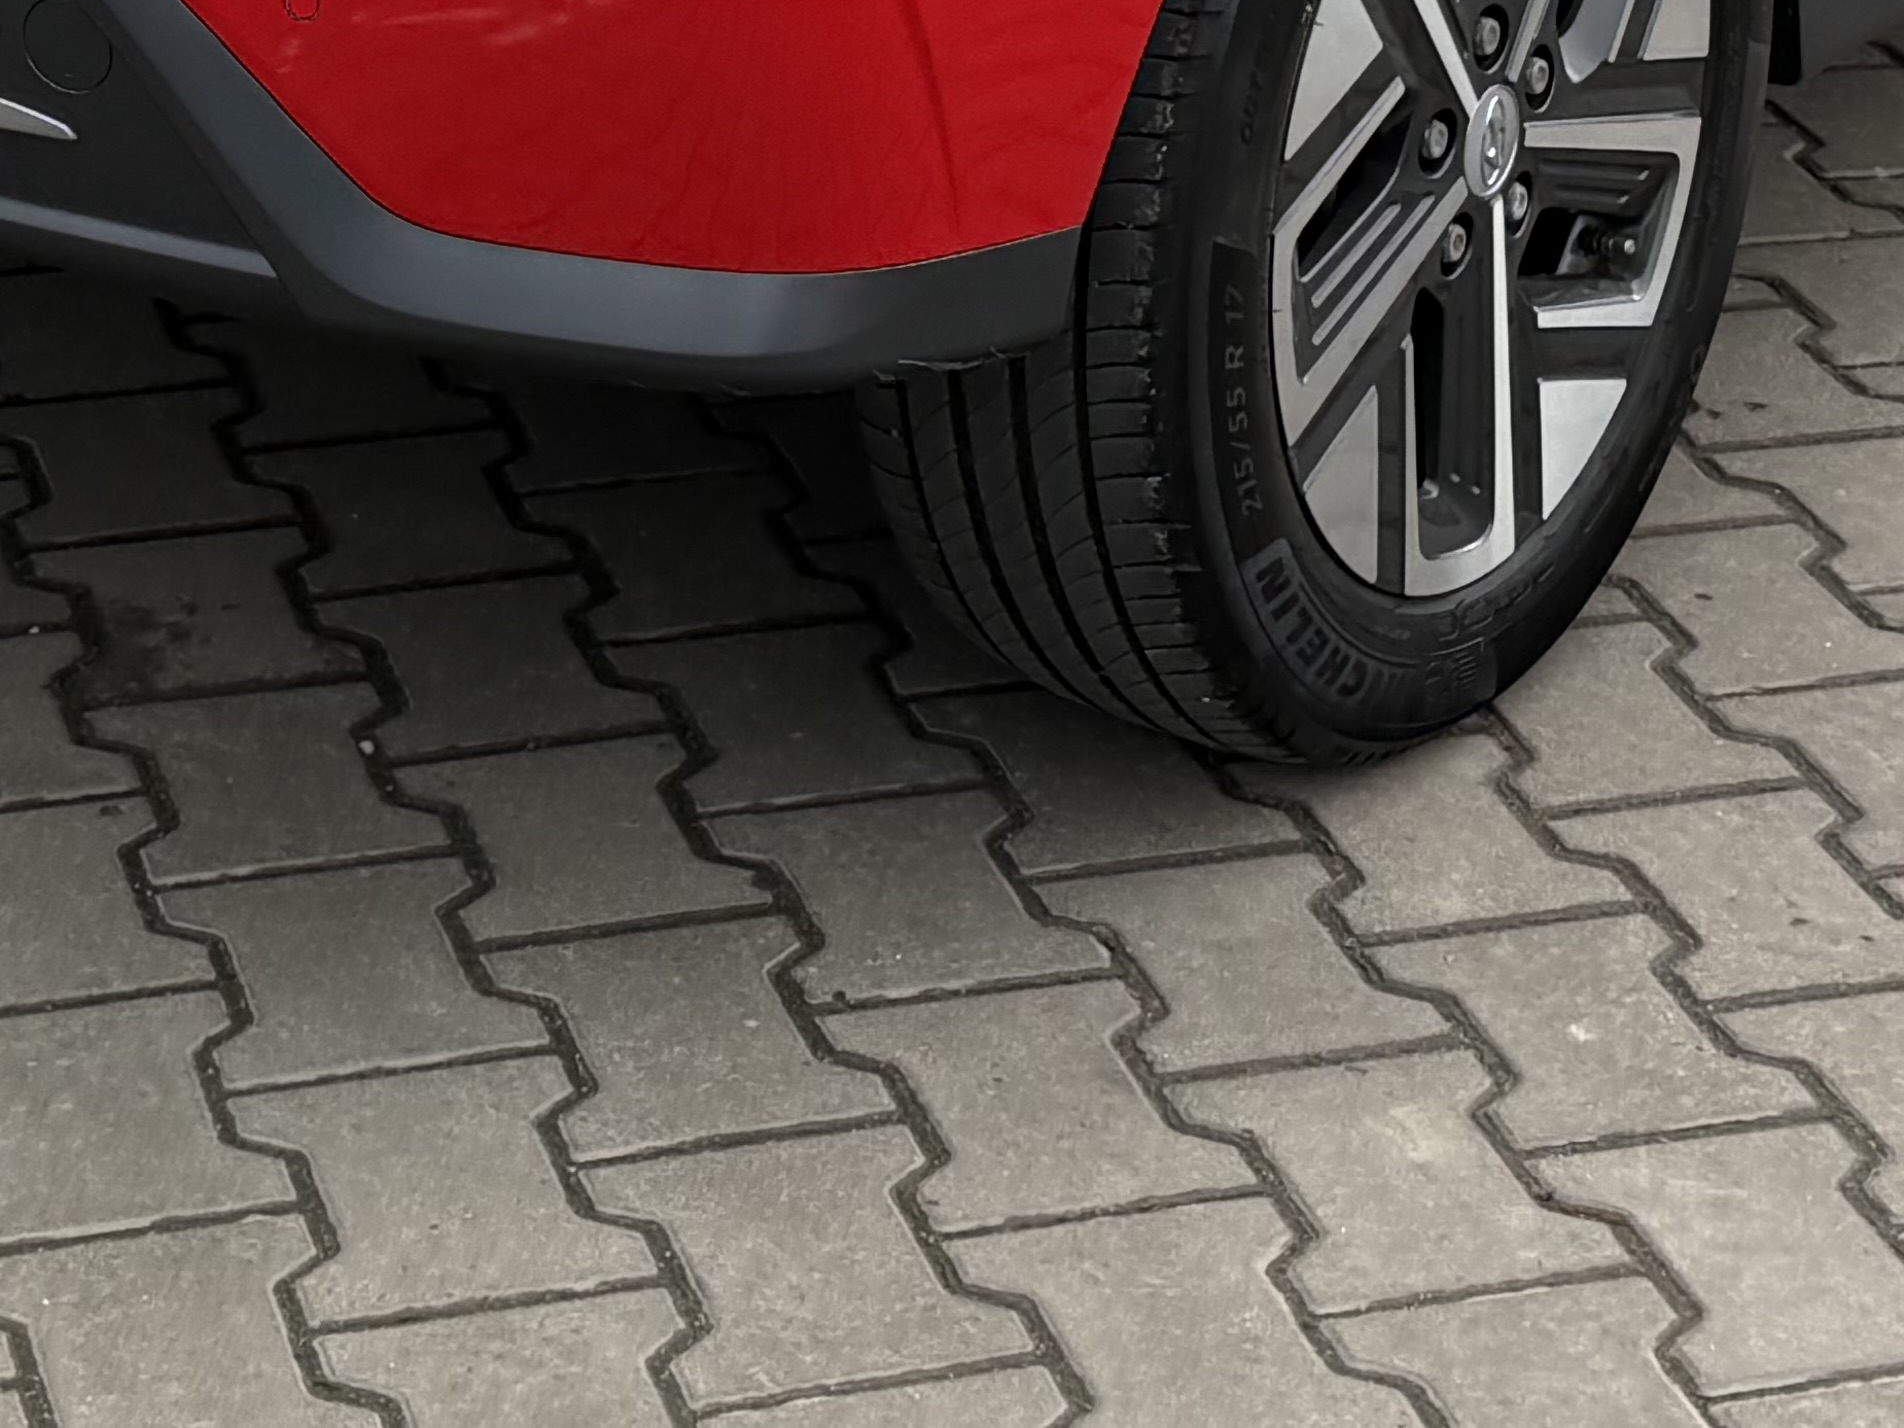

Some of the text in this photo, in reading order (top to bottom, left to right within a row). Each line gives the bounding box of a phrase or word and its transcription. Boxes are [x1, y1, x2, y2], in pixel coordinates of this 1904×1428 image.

[1224, 283, 1263, 516] 215/55 R 17
